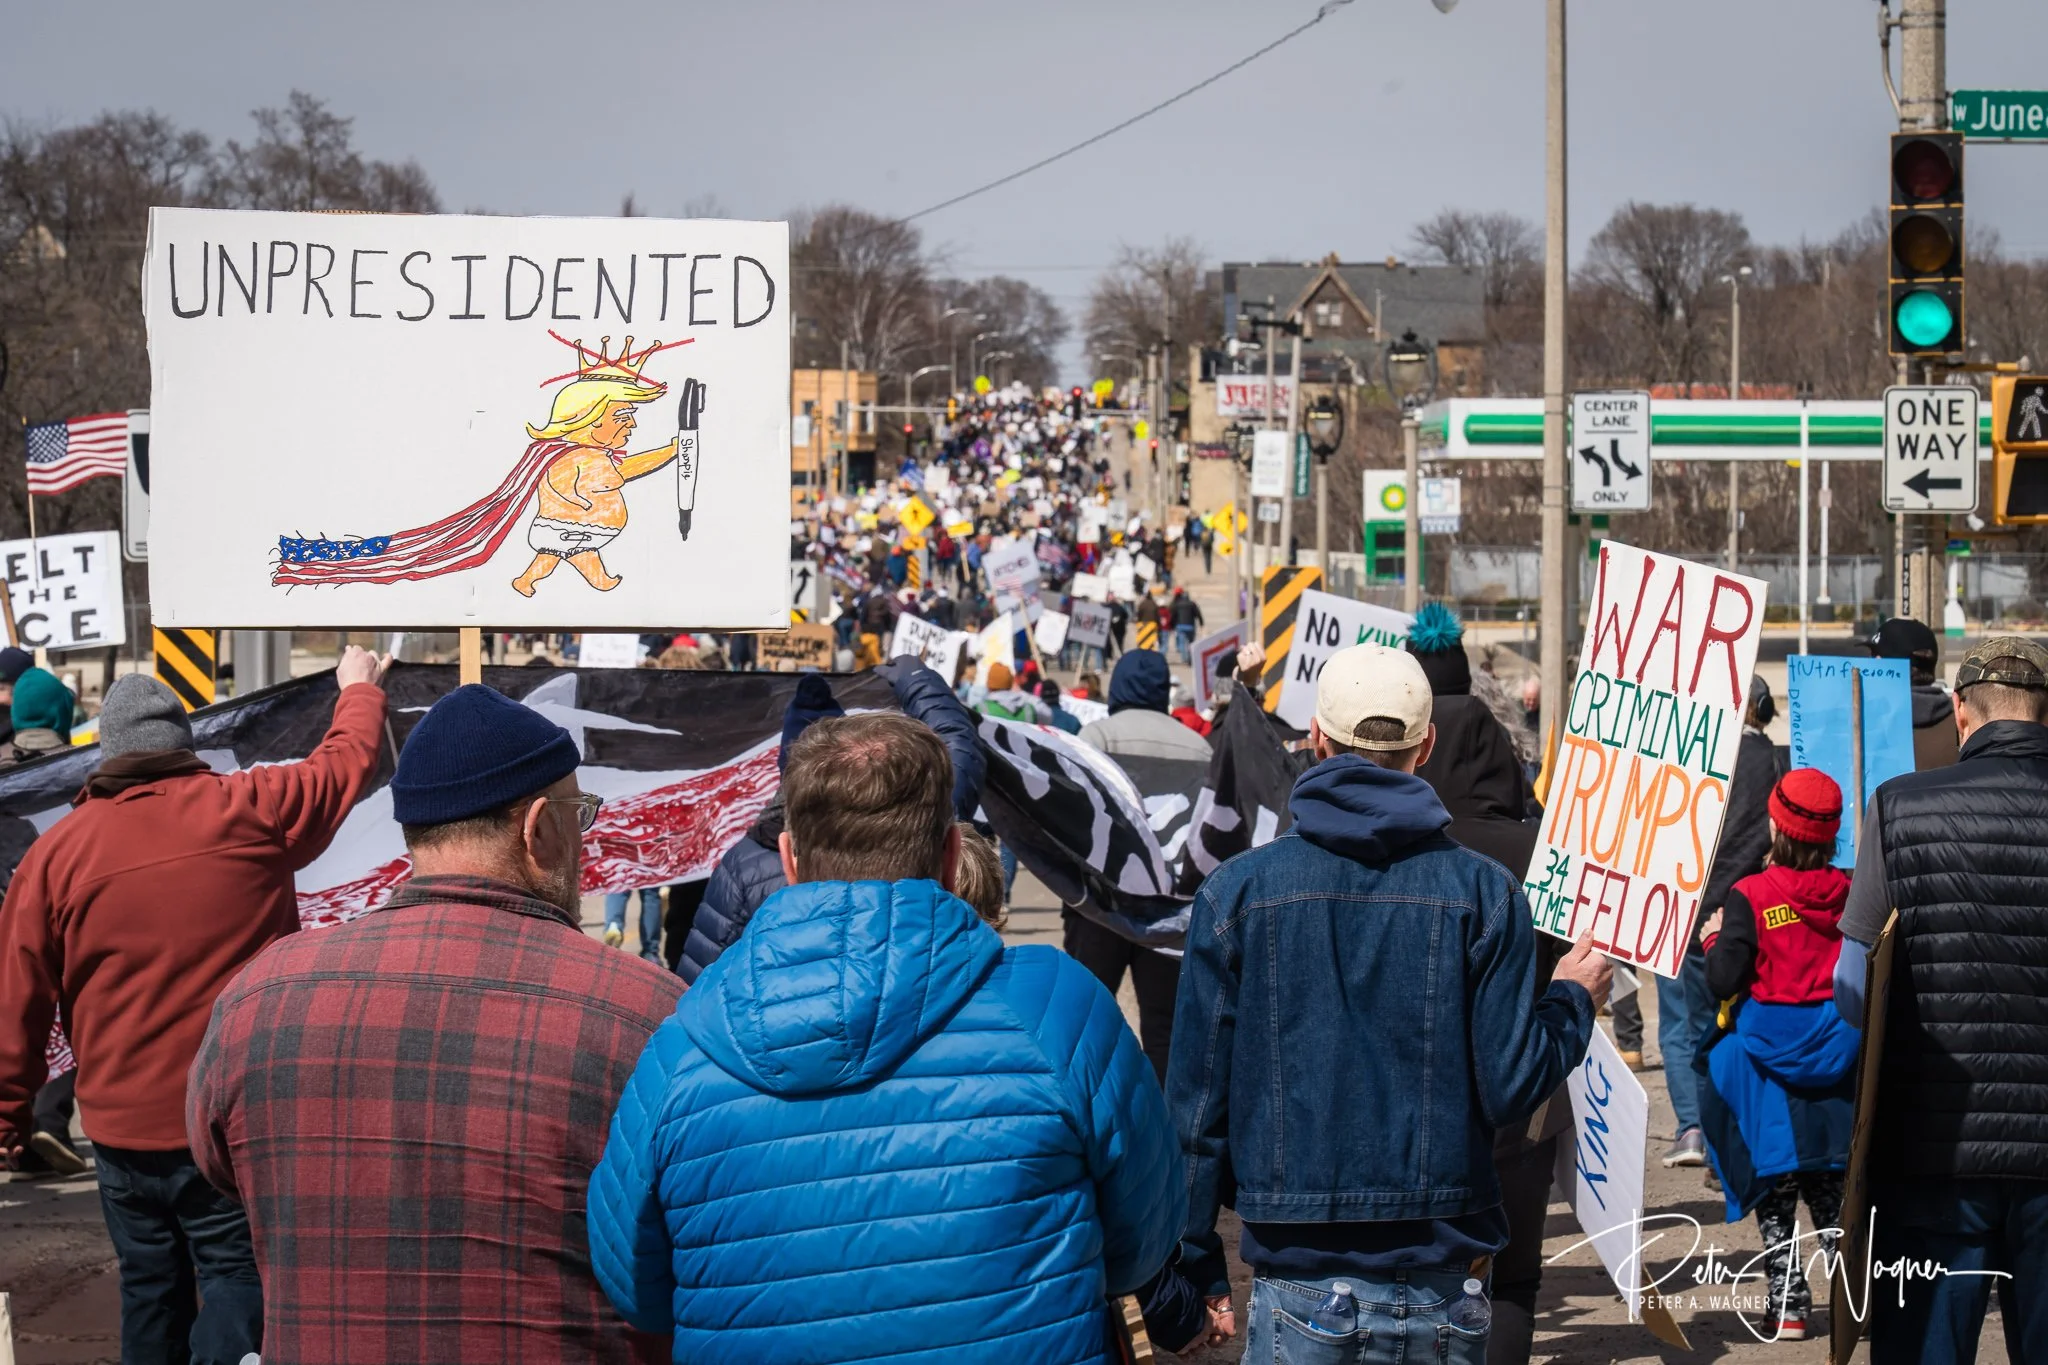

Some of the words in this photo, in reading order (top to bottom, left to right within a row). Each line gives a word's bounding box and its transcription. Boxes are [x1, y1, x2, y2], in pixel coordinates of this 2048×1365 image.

[1954, 104, 1967, 122] W
[1970, 96, 2048, 132] June
[170, 241, 776, 328] UNPRESIDENTED
[1584, 401, 1638, 412] CENTER
[1592, 415, 1631, 427] LANE
[1897, 399, 1965, 426] ONE
[679, 438, 693, 480] Sharpie
[1897, 433, 1967, 460] WAY
[1592, 491, 1629, 503] ONLY
[6, 545, 95, 584] ELT
[1305, 608, 1341, 647] NO
[1591, 546, 1754, 714] WAR
[1569, 670, 1730, 782] CRIMINAL
[1547, 733, 1725, 893] TRUMPS
[1539, 848, 1571, 893] 34
[1525, 881, 1575, 936] TIME
[1567, 862, 1698, 977] FELON
[1575, 1055, 1613, 1212] KING
